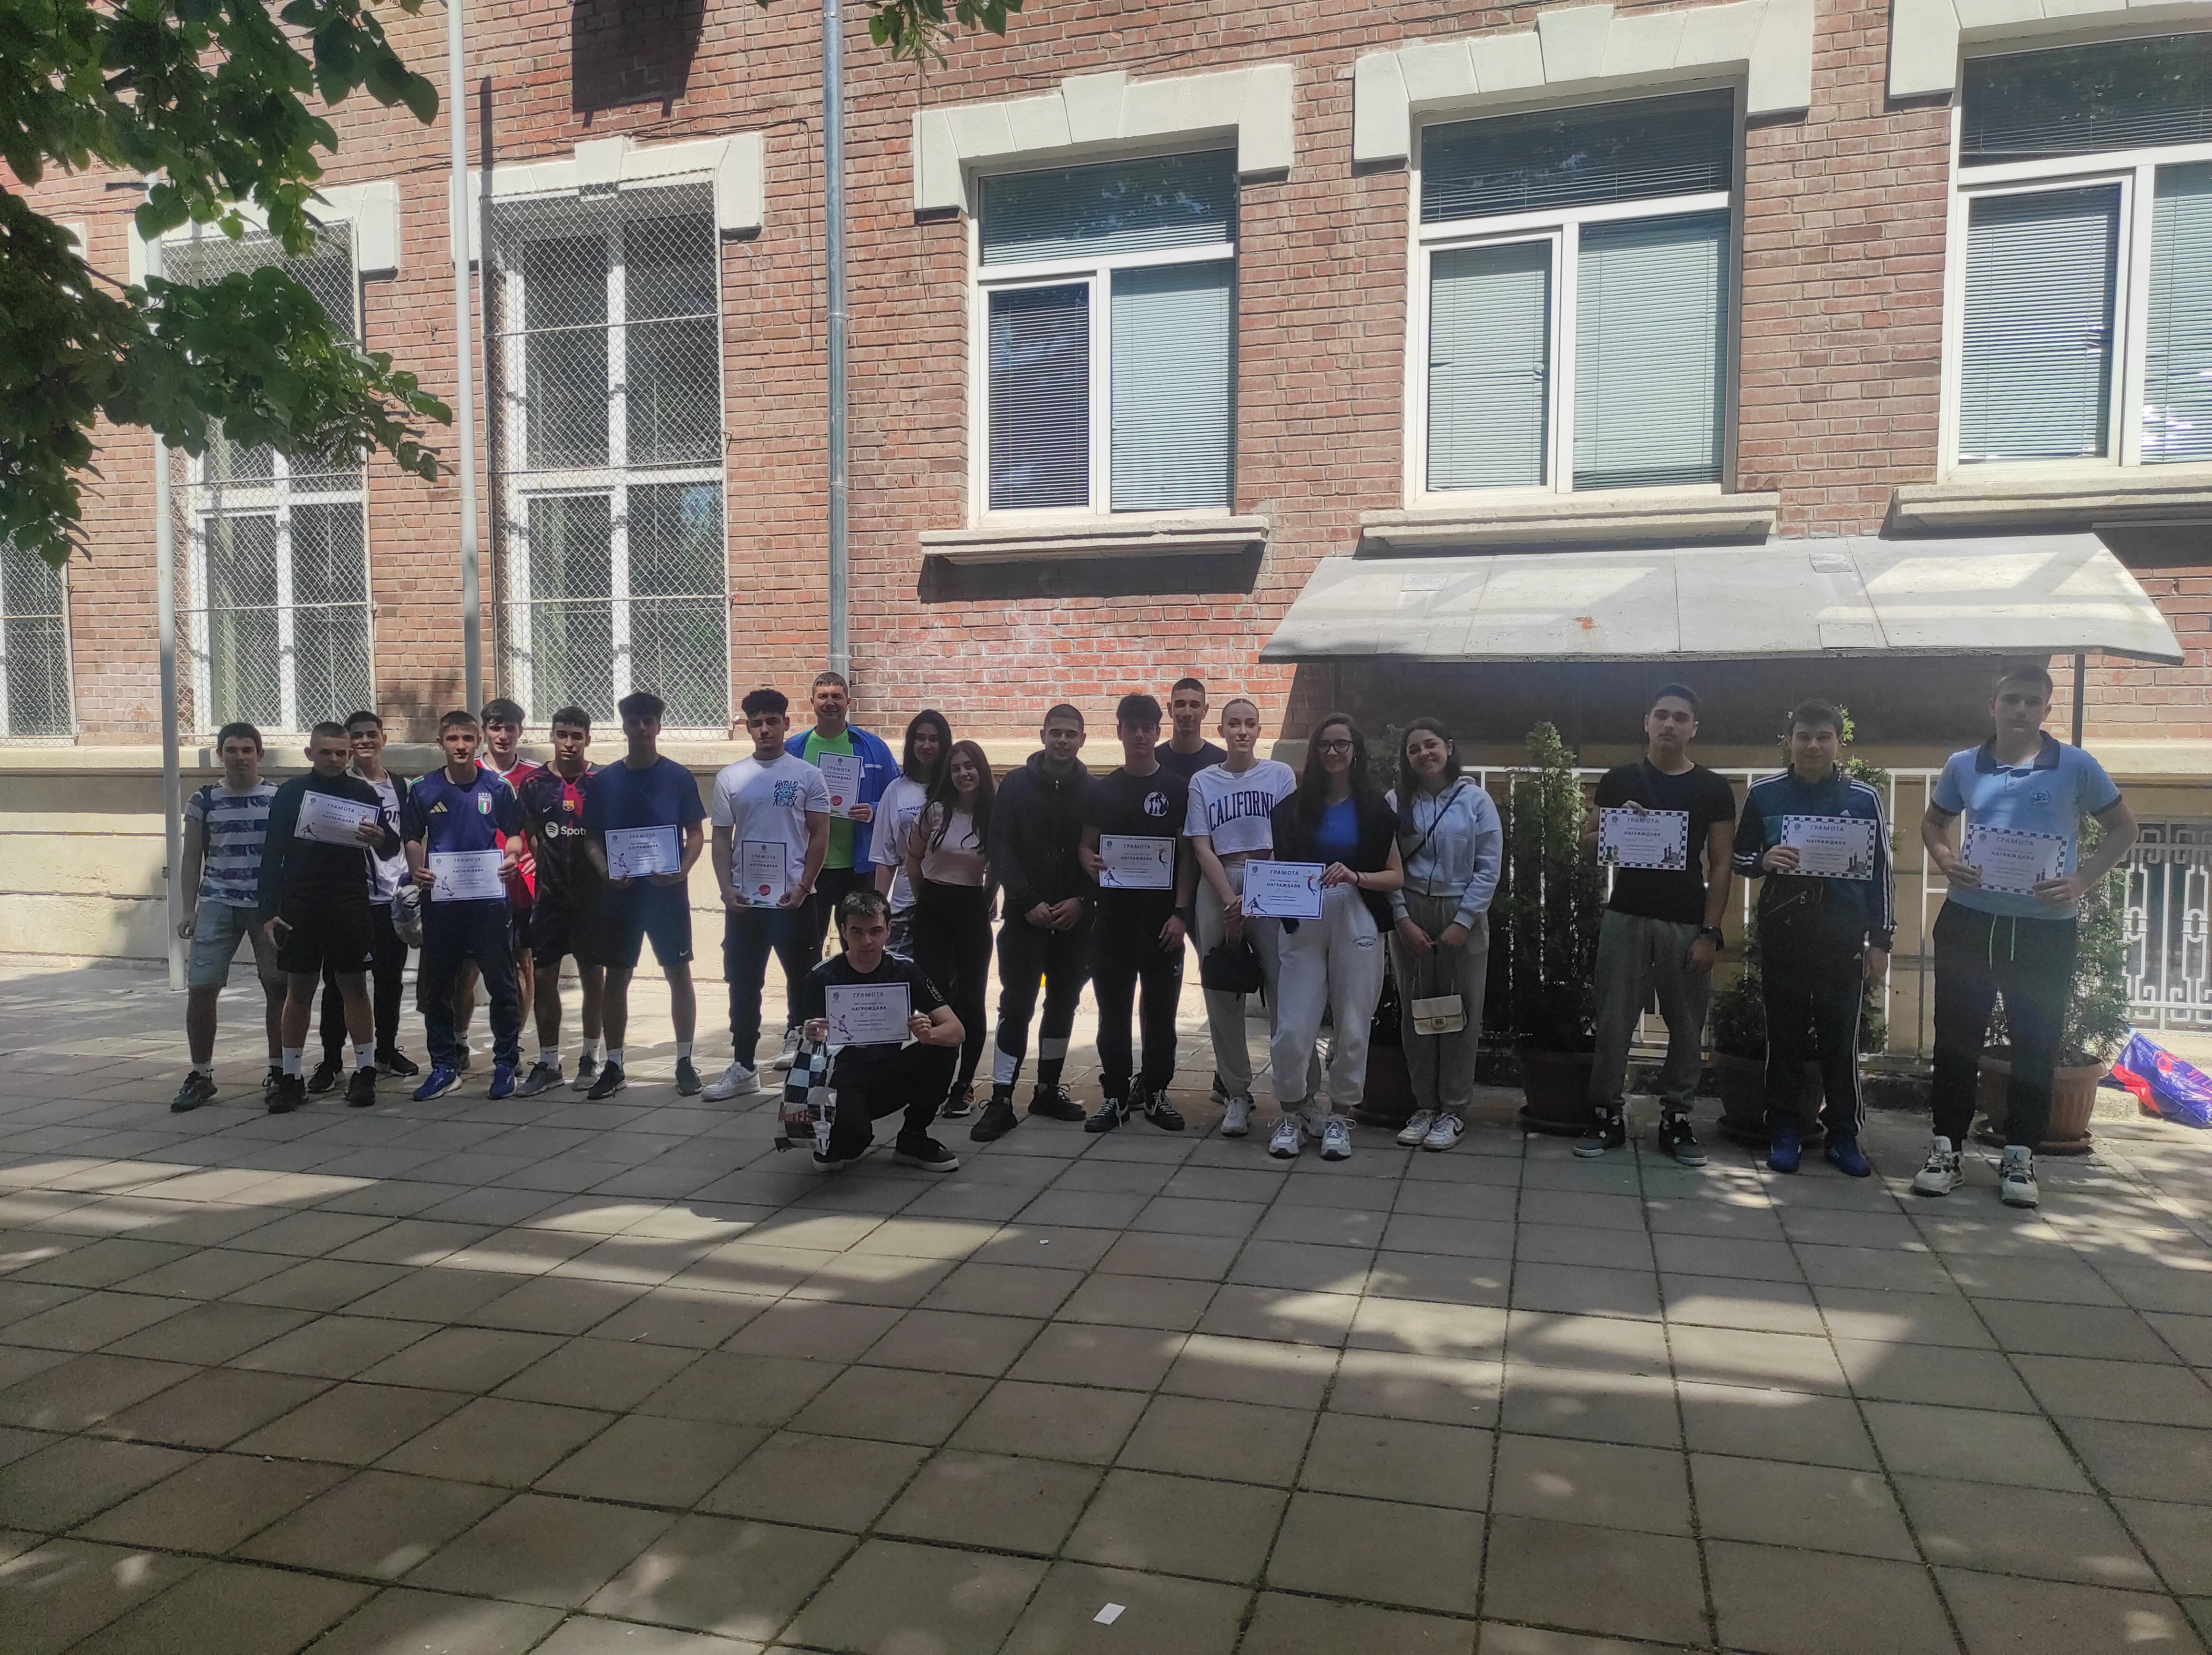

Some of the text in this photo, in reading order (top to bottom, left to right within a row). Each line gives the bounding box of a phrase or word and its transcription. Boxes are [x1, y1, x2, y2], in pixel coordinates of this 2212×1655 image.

[328, 803, 355, 813] ГРАМОТА
[1208, 790, 1276, 832] CALIFORNI
[322, 814, 354, 824] НАГРАЖДАВА
[561, 826, 586, 837] Spoti
[1997, 837, 2034, 847] ГРАМОТА
[1991, 851, 2035, 861] НАГРАЖДАВА
